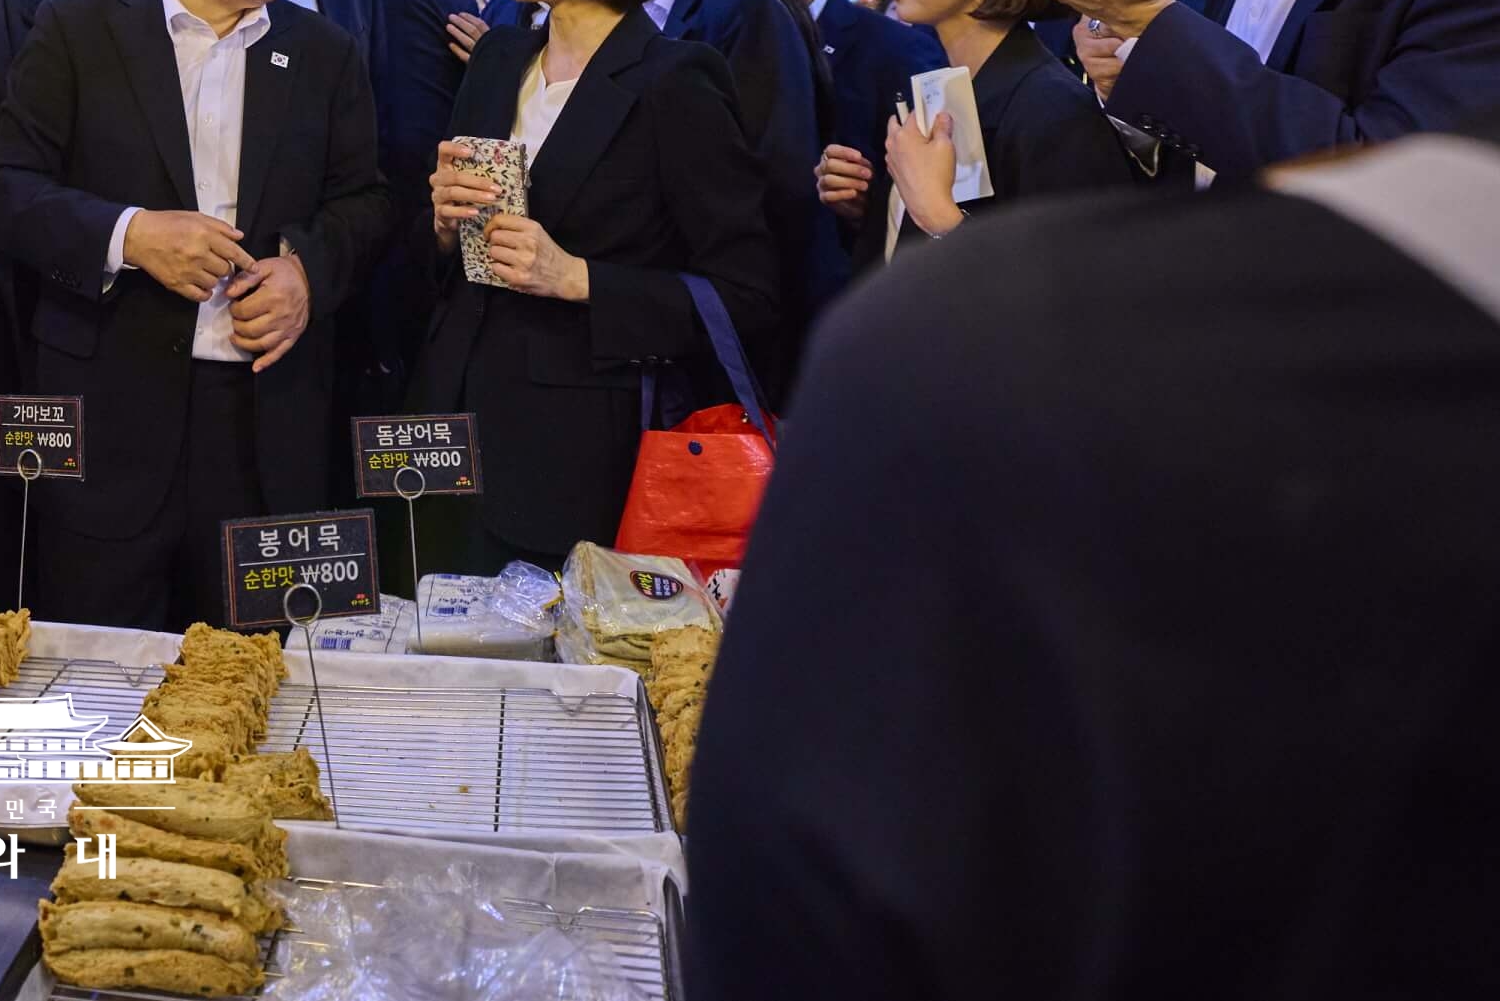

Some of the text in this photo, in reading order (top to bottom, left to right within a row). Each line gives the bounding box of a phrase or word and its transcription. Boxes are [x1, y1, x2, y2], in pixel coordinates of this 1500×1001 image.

[13, 404, 65, 423] 가마보꼬
[4, 431, 72, 448] 순한맛 ₩800
[376, 423, 452, 447] 돔살어묵
[368, 450, 461, 469] 순한맛 ₩800
[258, 523, 341, 558] 봉어묵
[244, 560, 359, 590] 순한맛 ₩800
